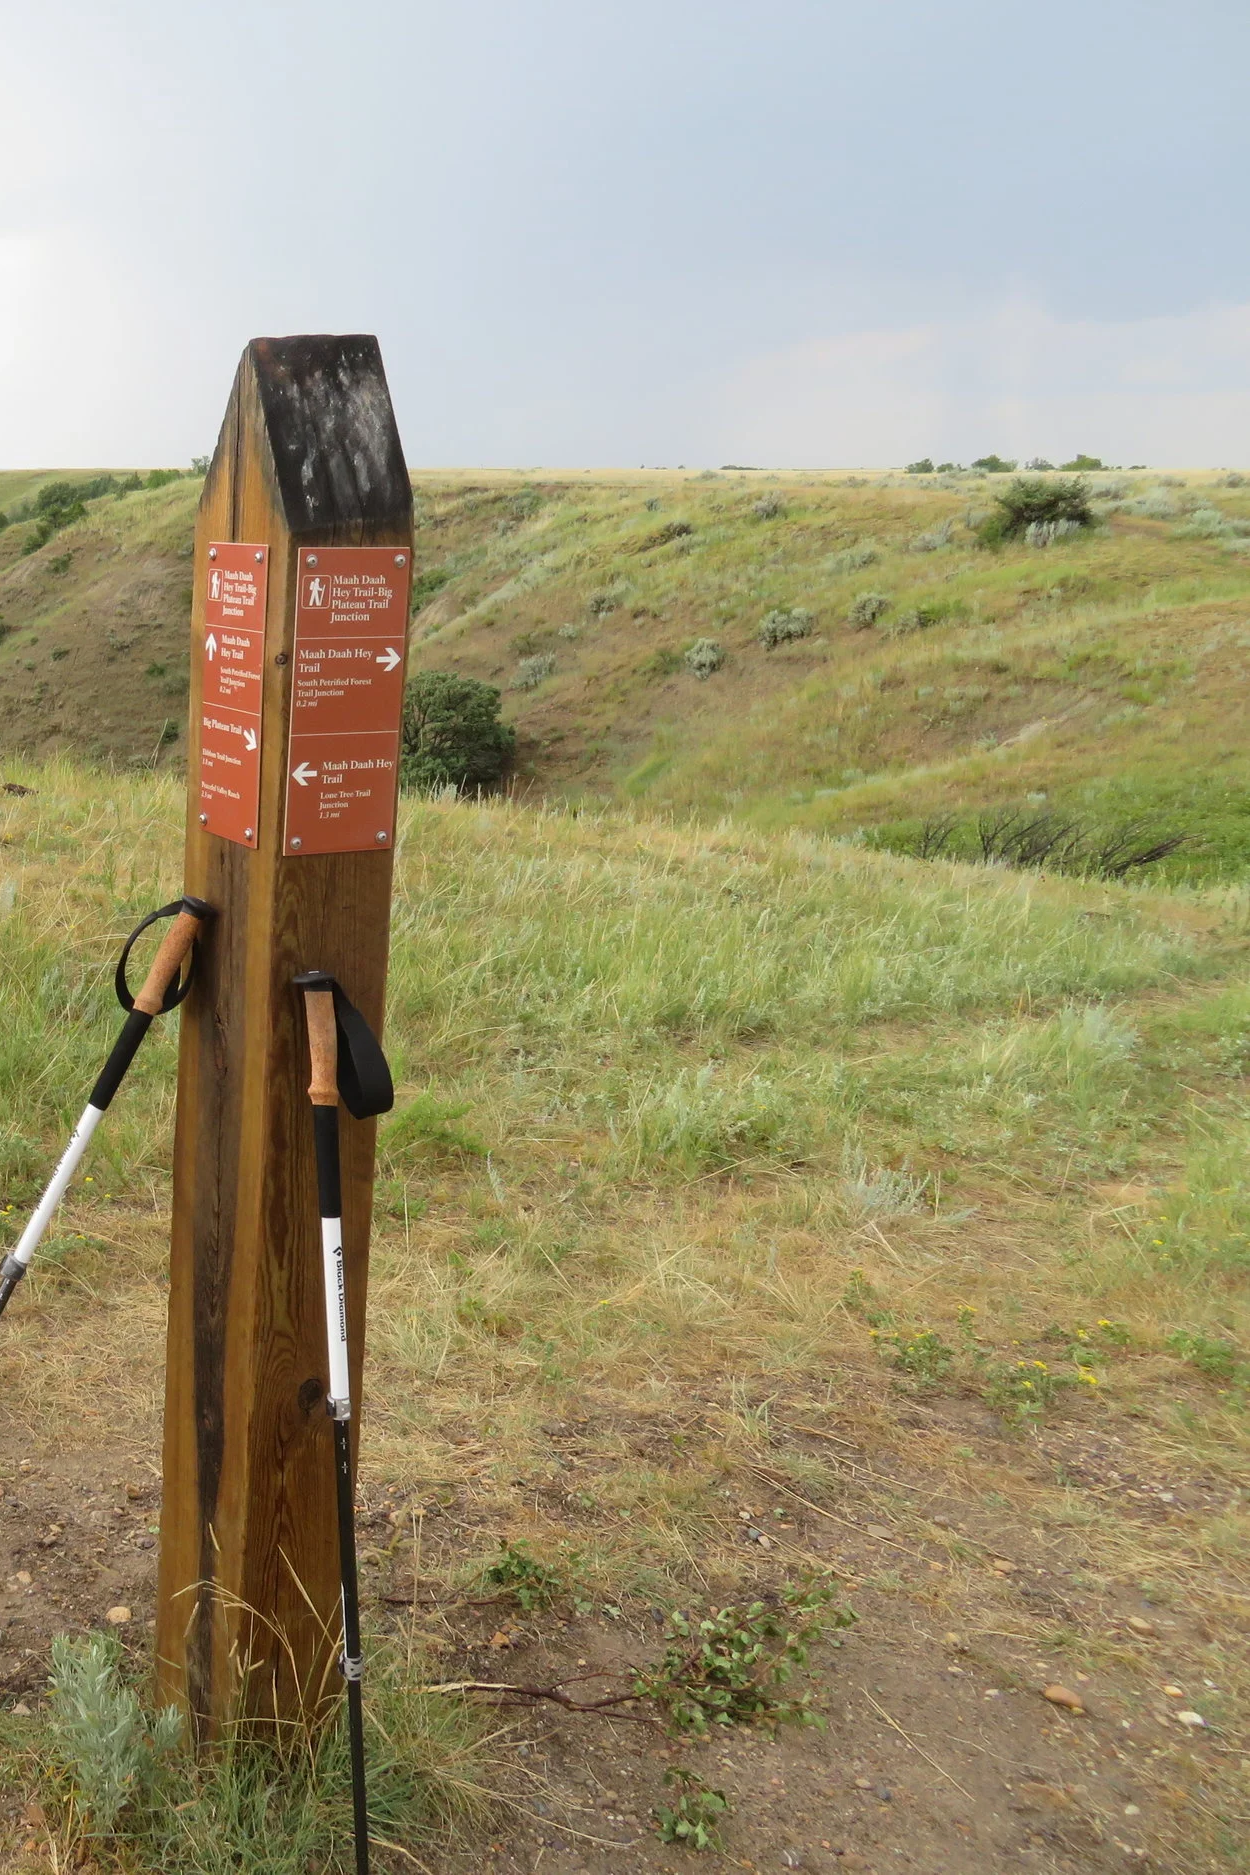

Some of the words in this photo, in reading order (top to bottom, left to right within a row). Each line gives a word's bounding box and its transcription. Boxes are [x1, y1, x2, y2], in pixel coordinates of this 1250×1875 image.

[333, 575, 359, 585] Maah
[362, 575, 386, 585] Daah
[332, 588, 351, 599] Hey
[353, 587, 393, 599] Trail-Big
[331, 600, 366, 610] Plateau
[368, 599, 389, 609] Trail
[330, 612, 370, 624] Junction
[299, 649, 326, 660] Maah
[328, 648, 352, 659] Daah
[354, 648, 373, 660] Hey
[298, 663, 320, 673] Trail
[297, 679, 318, 687] South
[319, 678, 349, 686] Petrified
[350, 678, 372, 686] Forest
[314, 689, 344, 698] Junction
[308, 699, 318, 707] mi
[322, 760, 348, 771] Maah
[350, 759, 374, 770] Daah
[376, 758, 394, 770] Hey
[321, 774, 343, 784] Trail
[320, 792, 338, 800] Lone
[339, 790, 354, 798] Tree
[355, 789, 371, 797] Trail
[318, 801, 349, 811] Junction
[336, 1260, 344, 1291] Black
[338, 1292, 347, 1342] Diamond
